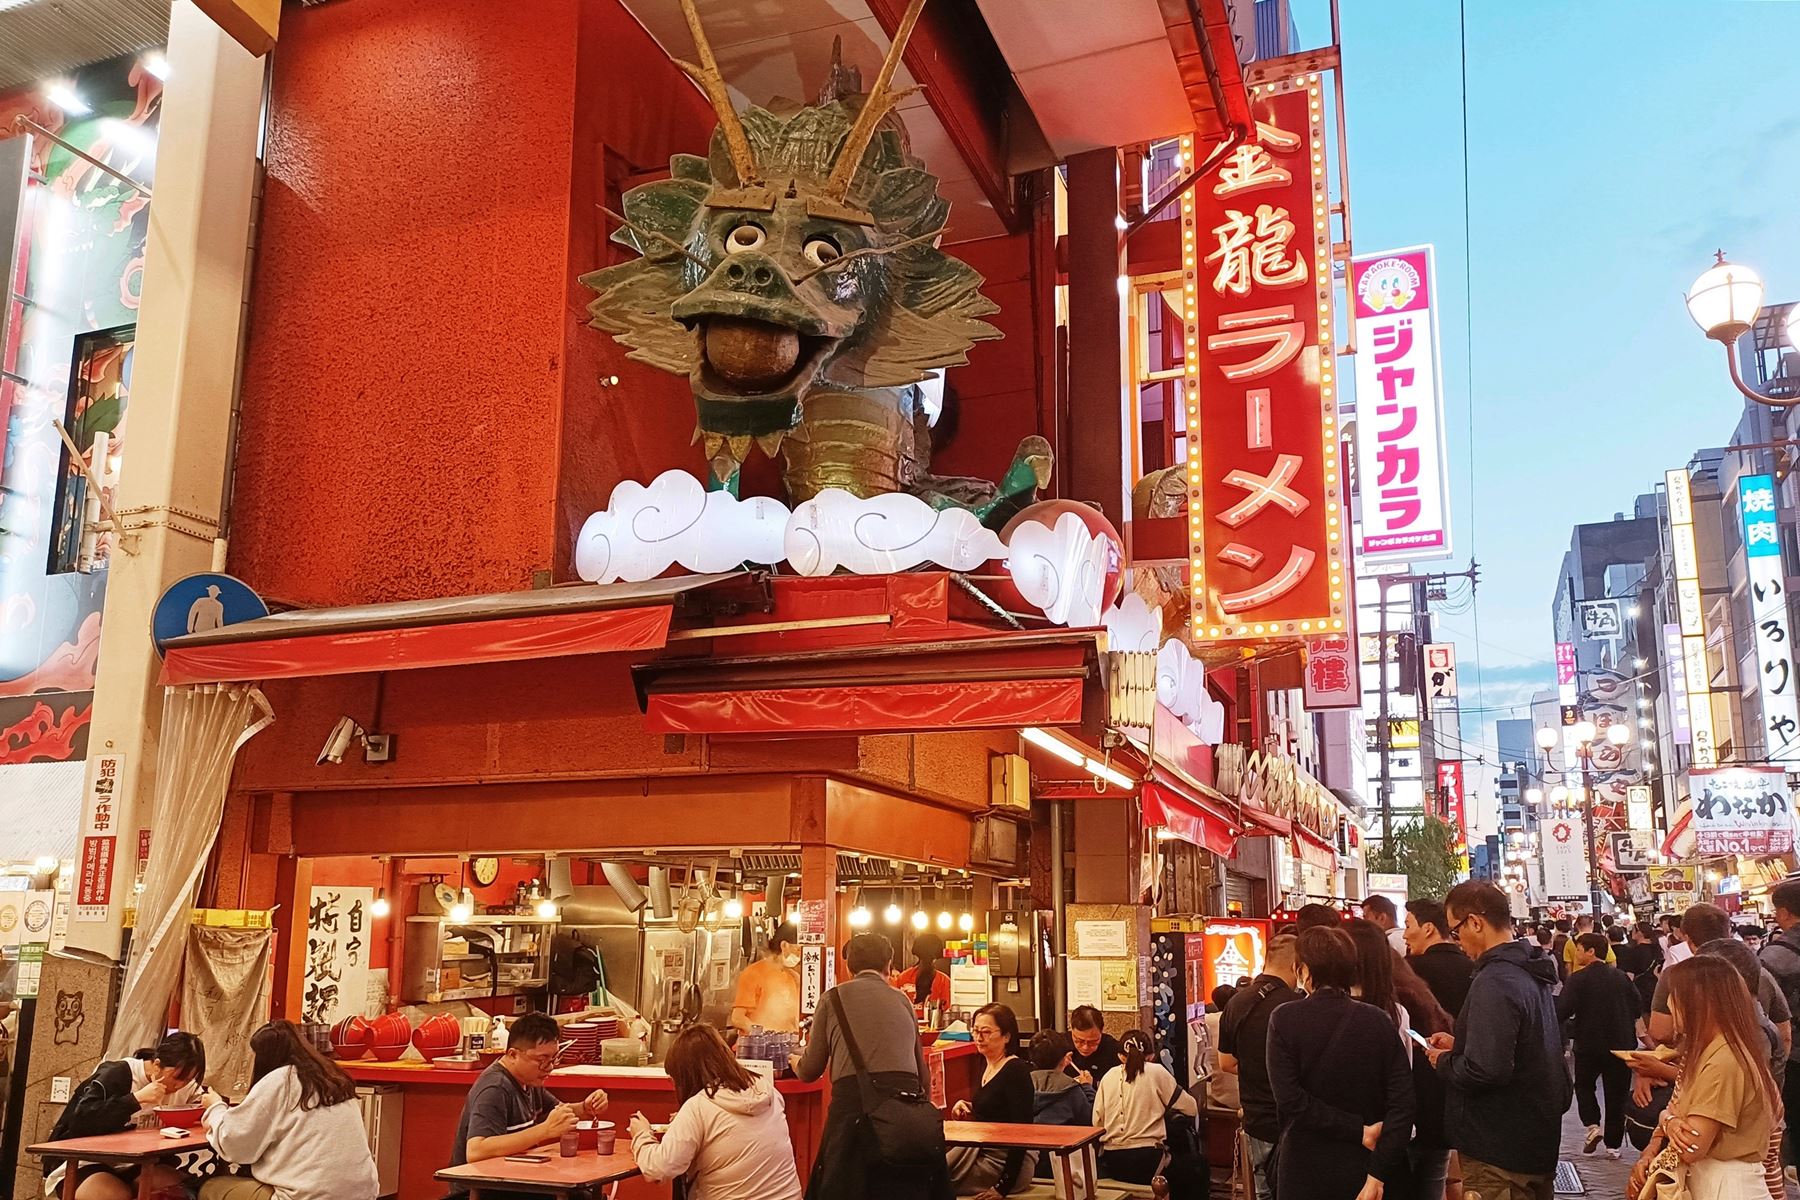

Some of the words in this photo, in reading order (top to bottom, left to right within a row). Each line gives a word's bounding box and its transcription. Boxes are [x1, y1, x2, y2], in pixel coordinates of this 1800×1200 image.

[1202, 120, 1316, 616] 金龍ラーメン
[1373, 318, 1422, 531] ジャンカラ
[1742, 488, 1780, 545] 焼肉
[1586, 609, 1616, 628] 牛角
[1753, 578, 1796, 746] いろりや
[94, 758, 117, 832] 防犯ラ作動中
[1694, 788, 1788, 820] わなか
[803, 951, 820, 962] 冷水
